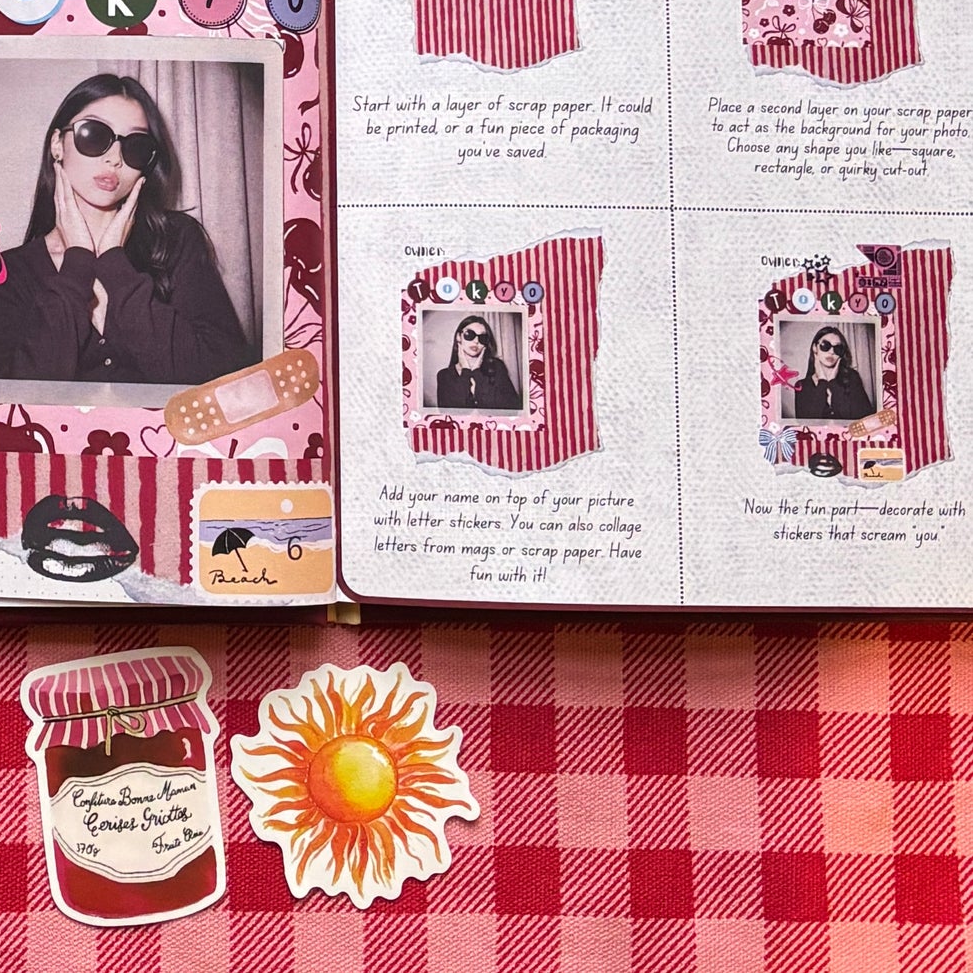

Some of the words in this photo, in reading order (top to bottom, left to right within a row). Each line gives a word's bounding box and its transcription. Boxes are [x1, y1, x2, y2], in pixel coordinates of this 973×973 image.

[352, 95, 390, 112] Start
[397, 95, 425, 111] with
[432, 100, 440, 111] a
[447, 95, 481, 118] layer
[488, 95, 504, 111] of
[508, 100, 546, 118] scrap
[601, 96, 612, 112] It
[619, 97, 652, 113] could
[709, 97, 742, 113] Place
[747, 105, 754, 113] a
[761, 100, 801, 114] second
[808, 100, 839, 121] layer
[844, 106, 858, 115] on
[864, 106, 891, 122] your
[897, 108, 931, 124] scrap
[367, 120, 381, 134] be
[445, 124, 459, 134] or
[466, 124, 473, 134] a
[481, 118, 504, 134] fun
[510, 121, 545, 141] piece
[551, 119, 567, 135] of
[571, 120, 639, 144] packaging
[712, 118, 723, 132] to
[730, 119, 749, 133] act
[755, 125, 769, 133] as
[776, 120, 794, 134] the
[801, 120, 871, 141] background
[877, 121, 895, 135] for
[901, 127, 929, 143] your
[727, 137, 770, 153] Choose
[776, 144, 798, 159] any
[804, 140, 840, 161] shape
[846, 145, 867, 161] you
[820, 165, 833, 174] or
[839, 162, 877, 182] quirky
[379, 484, 403, 500] Add
[409, 490, 438, 508] your
[444, 494, 479, 503] name
[485, 495, 499, 503] on
[506, 489, 527, 510] top
[533, 489, 549, 505] of
[553, 496, 583, 512] your
[588, 491, 634, 513] picture
[744, 499, 772, 515] Now
[779, 499, 798, 515] the
[804, 500, 825, 515] fun
[939, 501, 965, 516] with
[374, 510, 401, 526] with
[407, 513, 444, 527] letter
[510, 514, 533, 529] You
[540, 521, 562, 531] can
[568, 517, 593, 531] also
[599, 517, 641, 539] collage
[774, 525, 822, 540] stickers
[828, 525, 855, 540] that
[861, 532, 906, 541] scream
[287, 536, 302, 560] 6
[375, 536, 416, 552] letters
[424, 537, 455, 553] from
[462, 546, 496, 561] mags
[502, 546, 515, 555] or
[522, 547, 558, 563] scrap
[610, 543, 641, 558] Have
[209, 568, 278, 585] Beach
[470, 565, 492, 581] fun
[499, 566, 526, 582] with
[533, 567, 547, 582] it!
